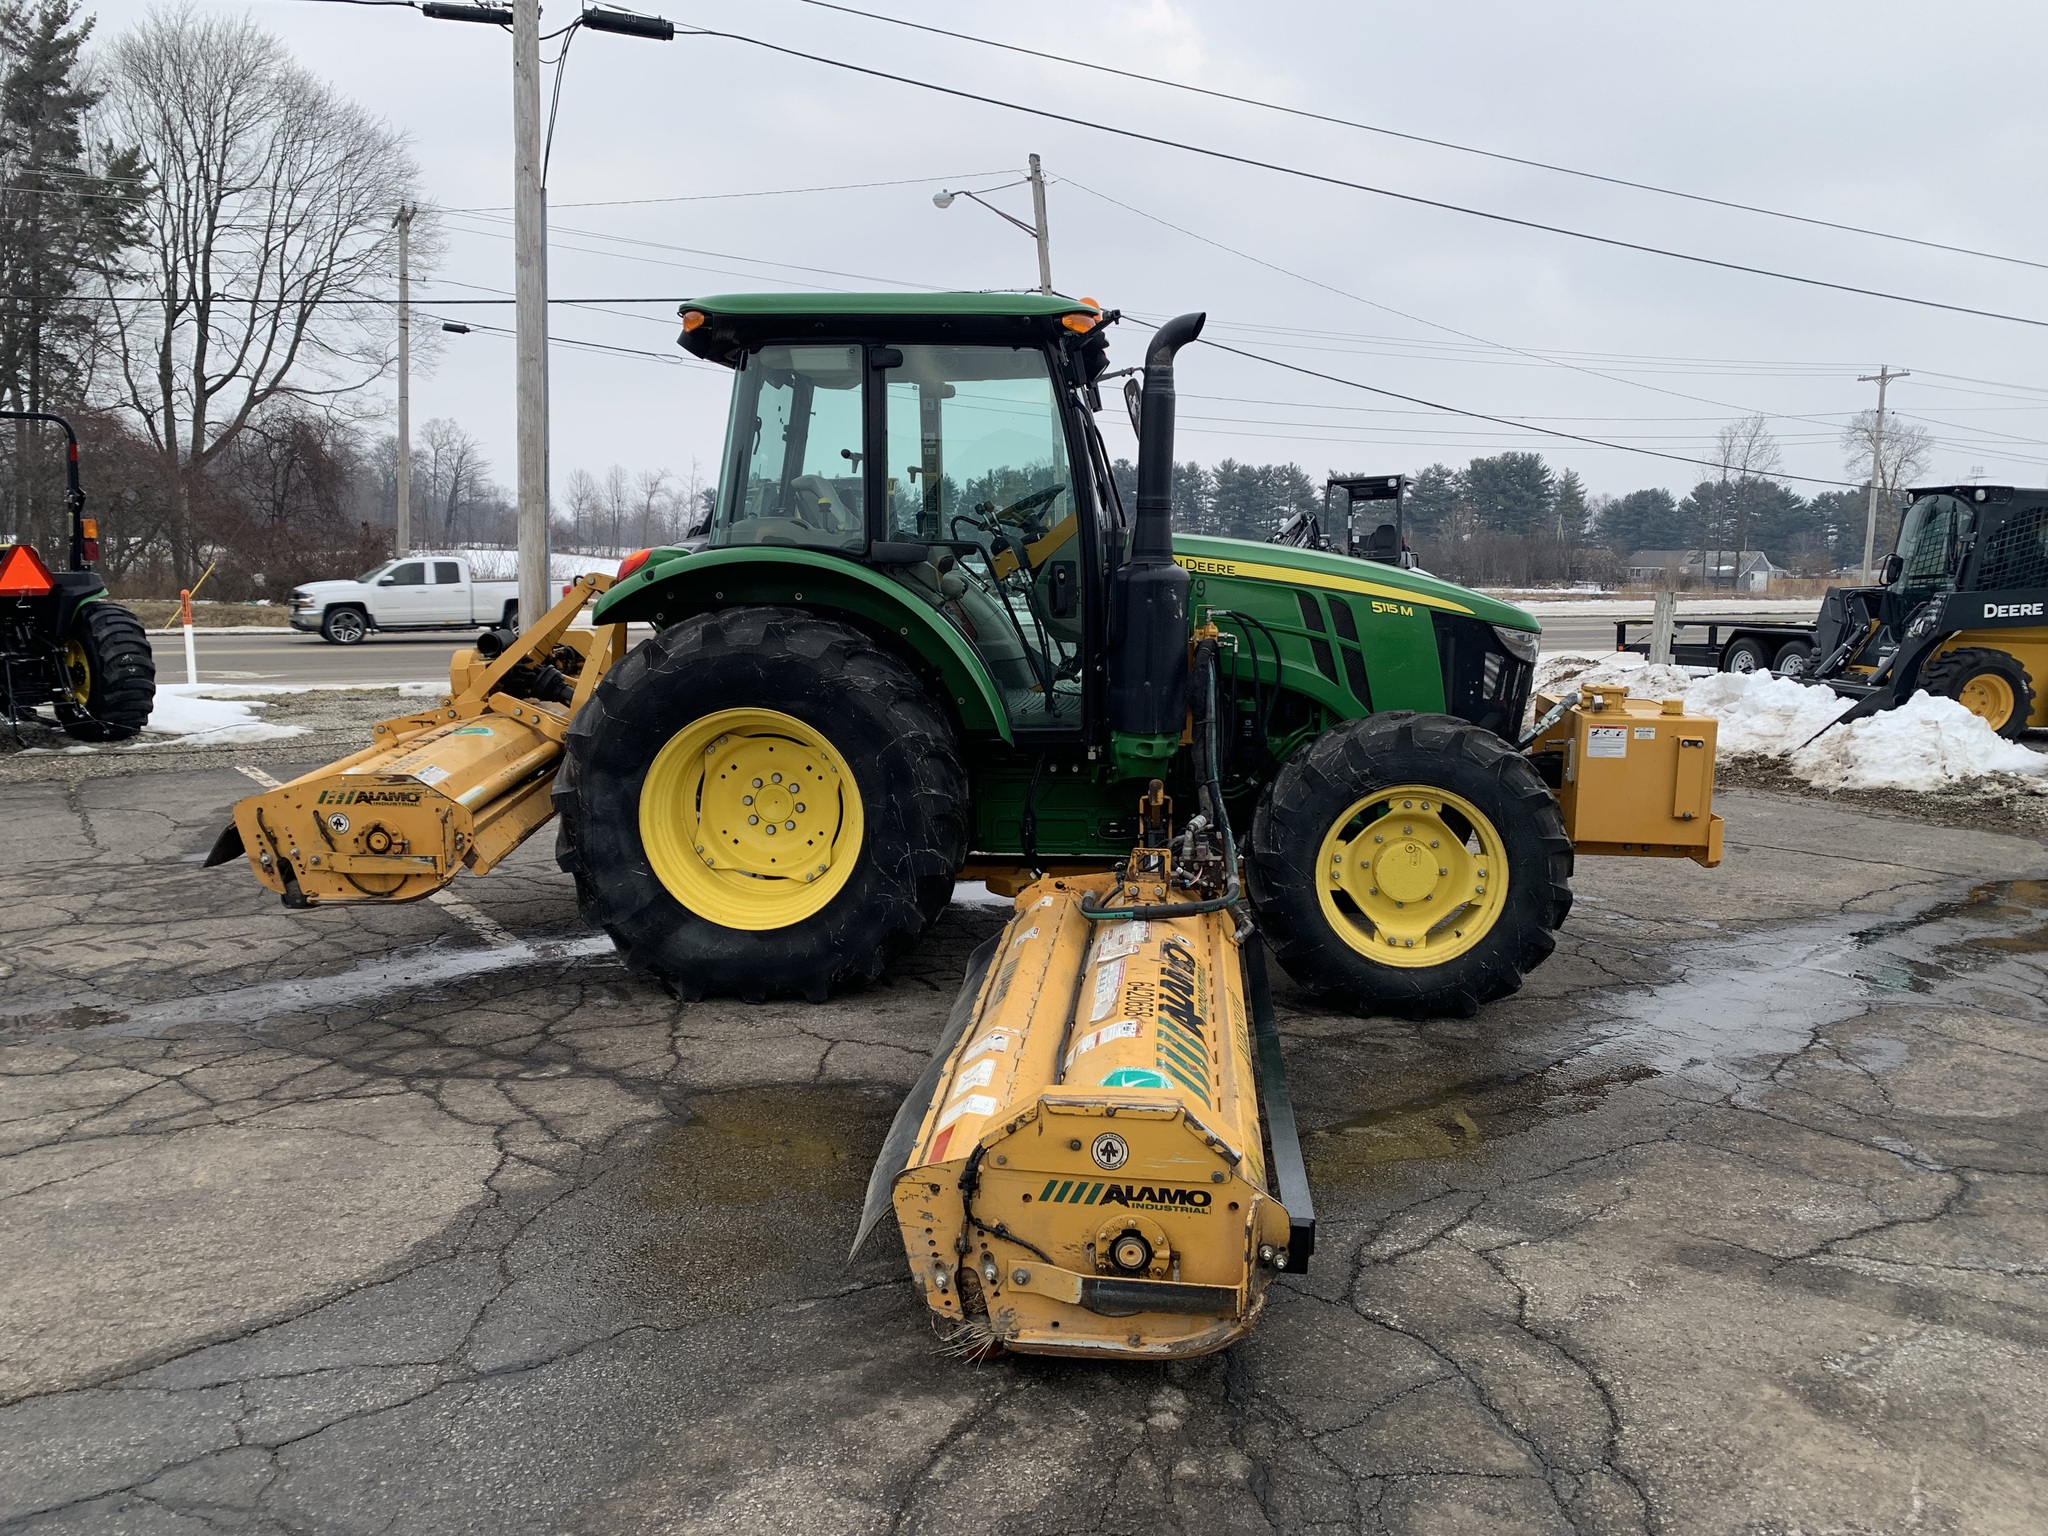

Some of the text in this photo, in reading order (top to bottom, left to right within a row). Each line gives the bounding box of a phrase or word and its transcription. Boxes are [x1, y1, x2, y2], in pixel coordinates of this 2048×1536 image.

[1186, 558, 1236, 575] DEERE
[1983, 602, 2044, 619] DEERE
[354, 790, 421, 805] ALAMO
[1099, 1184, 1212, 1208] ALAMO
[1131, 1202, 1209, 1214] INDUSTRIAL
